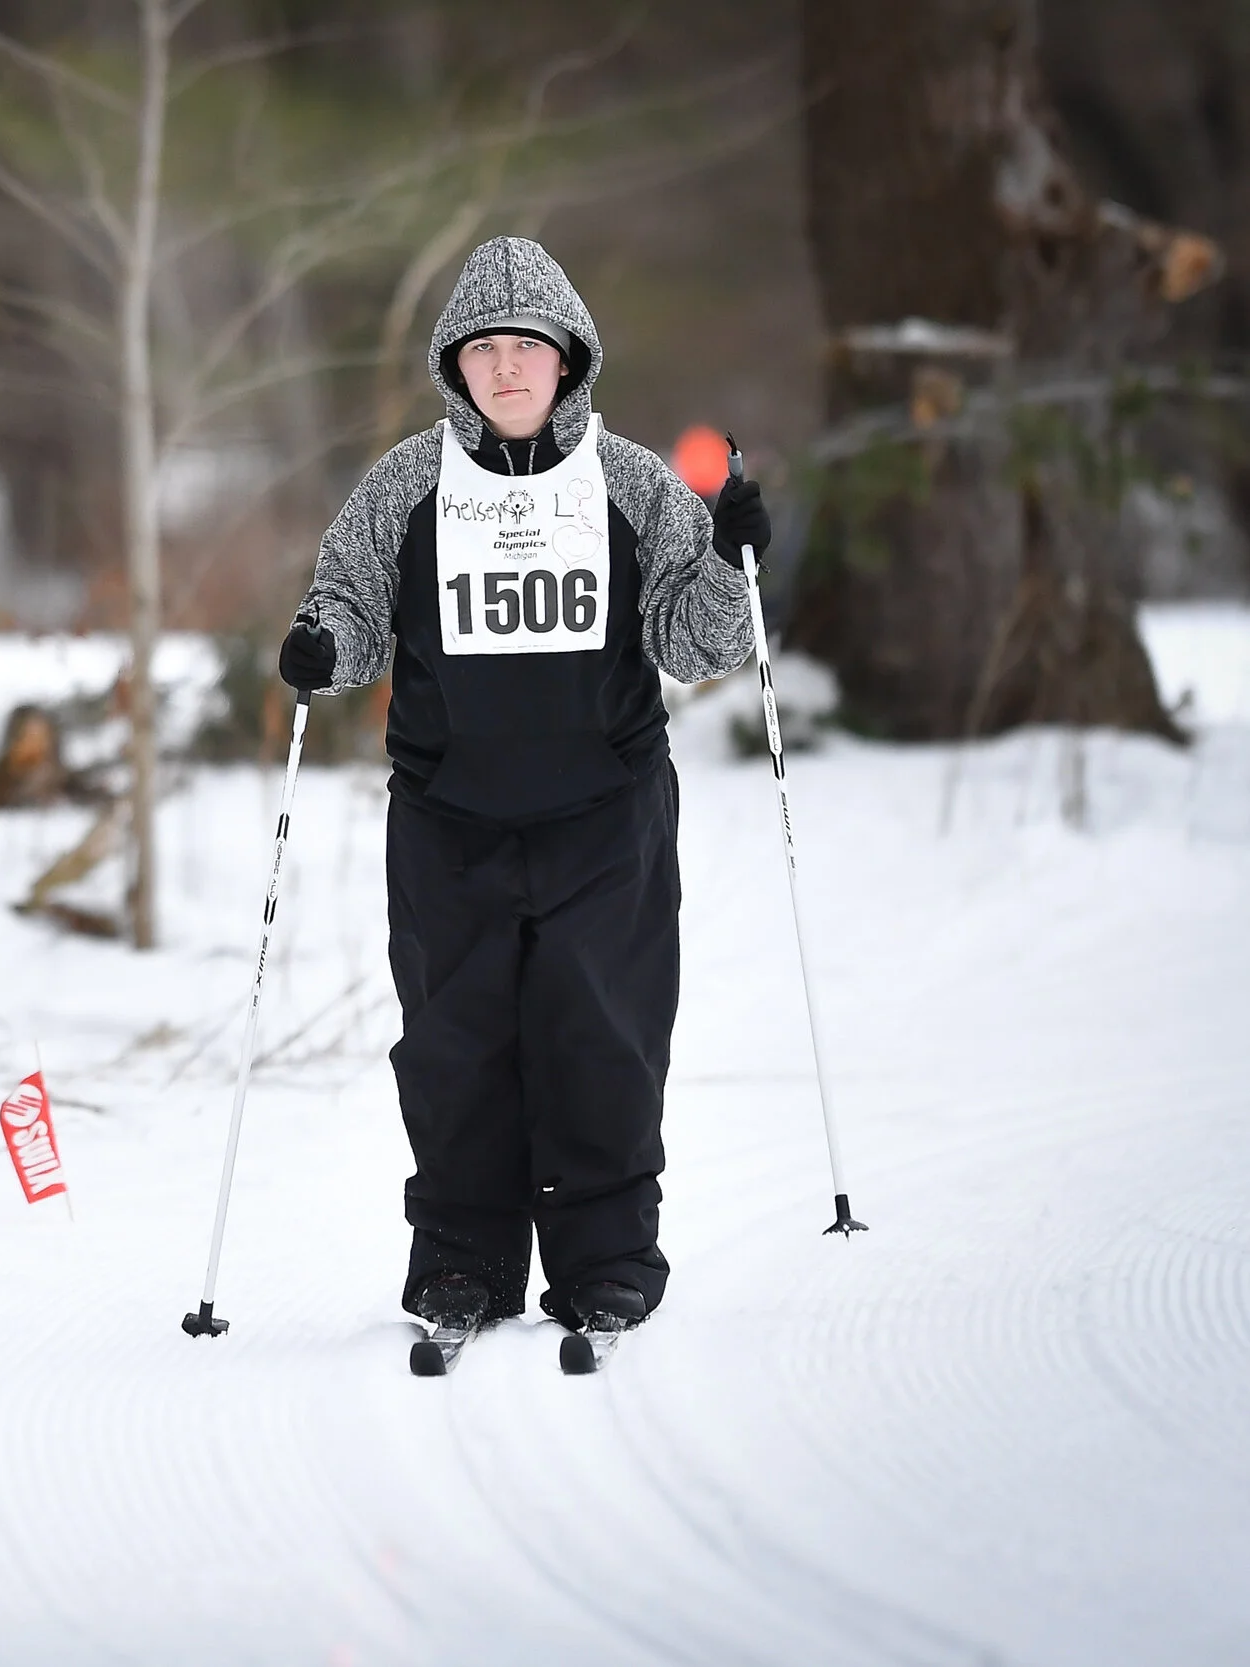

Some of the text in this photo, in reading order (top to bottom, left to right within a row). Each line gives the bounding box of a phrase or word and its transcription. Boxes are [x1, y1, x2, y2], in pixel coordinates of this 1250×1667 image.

[442, 493, 575, 523] Kelsey L
[493, 539, 547, 551] Olympics
[498, 528, 541, 540] Special
[503, 552, 538, 561] Michigan
[446, 569, 598, 635] 1506
[780, 791, 793, 847] SWIX
[274, 841, 282, 875] NORDIC
[256, 934, 267, 988] SWIX
[12, 1120, 64, 1195] SWIX
